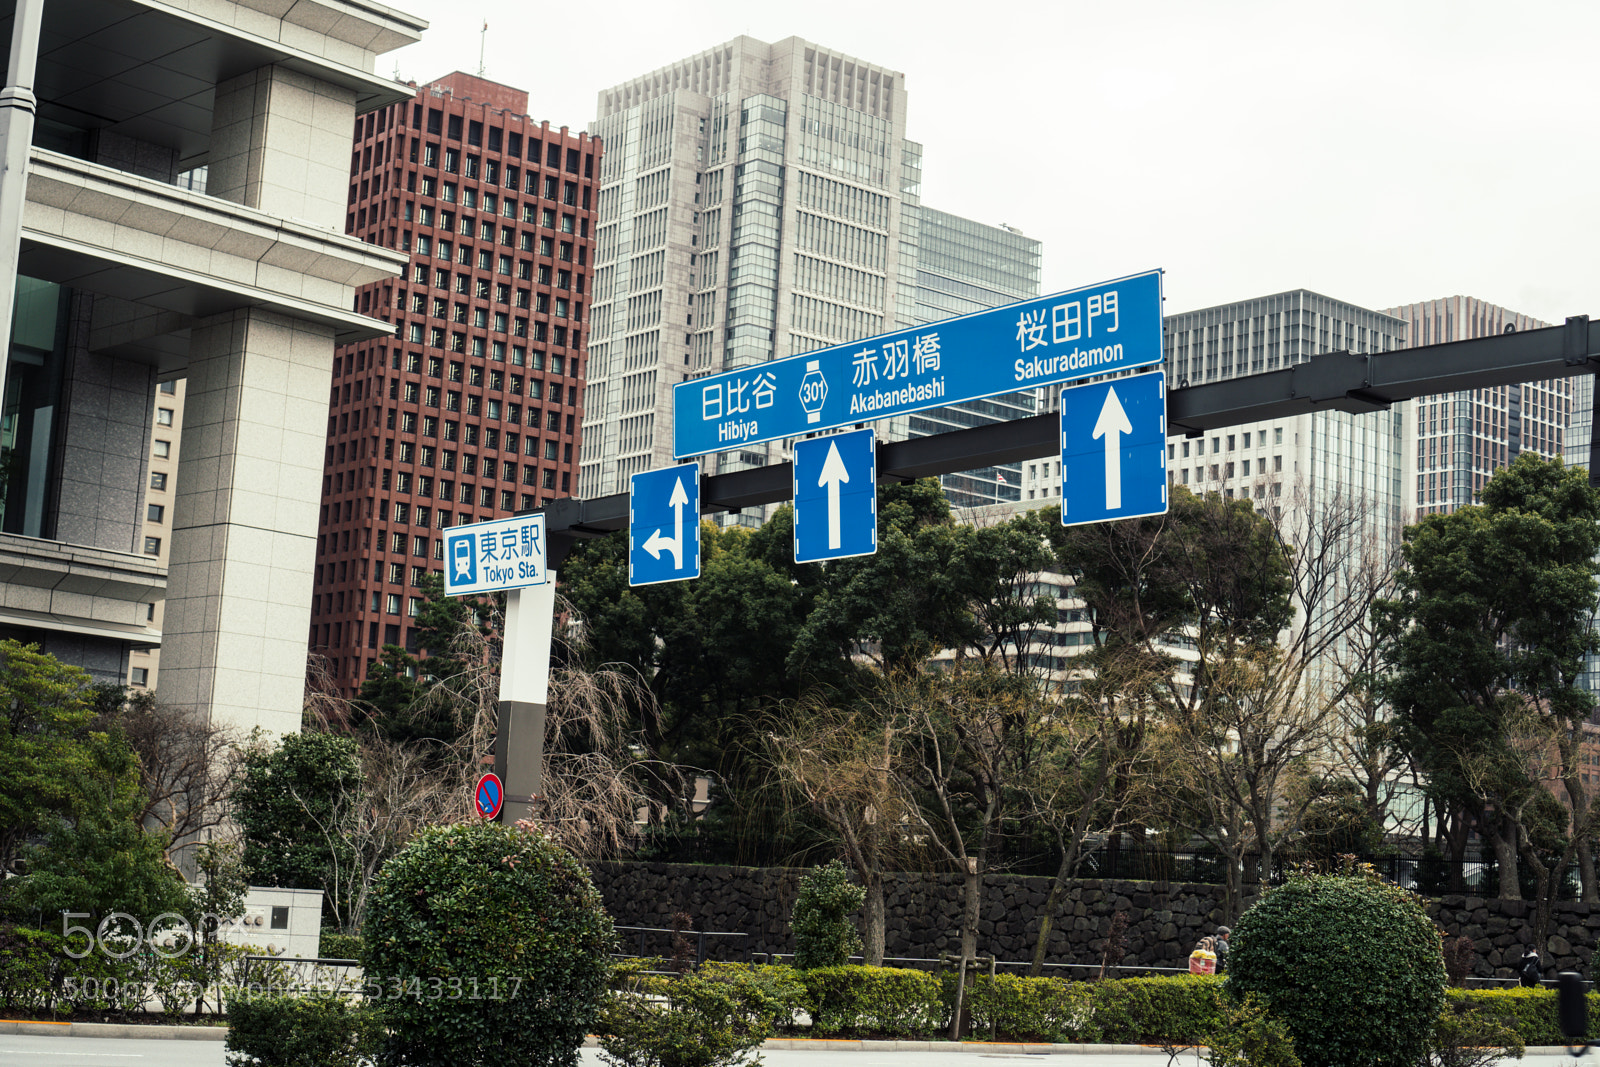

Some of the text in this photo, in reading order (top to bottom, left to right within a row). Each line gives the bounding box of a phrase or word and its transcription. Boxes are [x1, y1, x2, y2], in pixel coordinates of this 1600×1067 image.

[1015, 289, 1120, 353] 桜田門
[851, 331, 942, 388] 赤羽橋
[1013, 342, 1125, 382] Sakuradamon
[701, 371, 777, 421] 日比谷
[803, 379, 825, 403] 301
[849, 375, 946, 415] Akabanebashi
[717, 418, 759, 443] Hibiya
[479, 524, 541, 563] 東京駅
[483, 561, 539, 584] Tokyo Sta.
